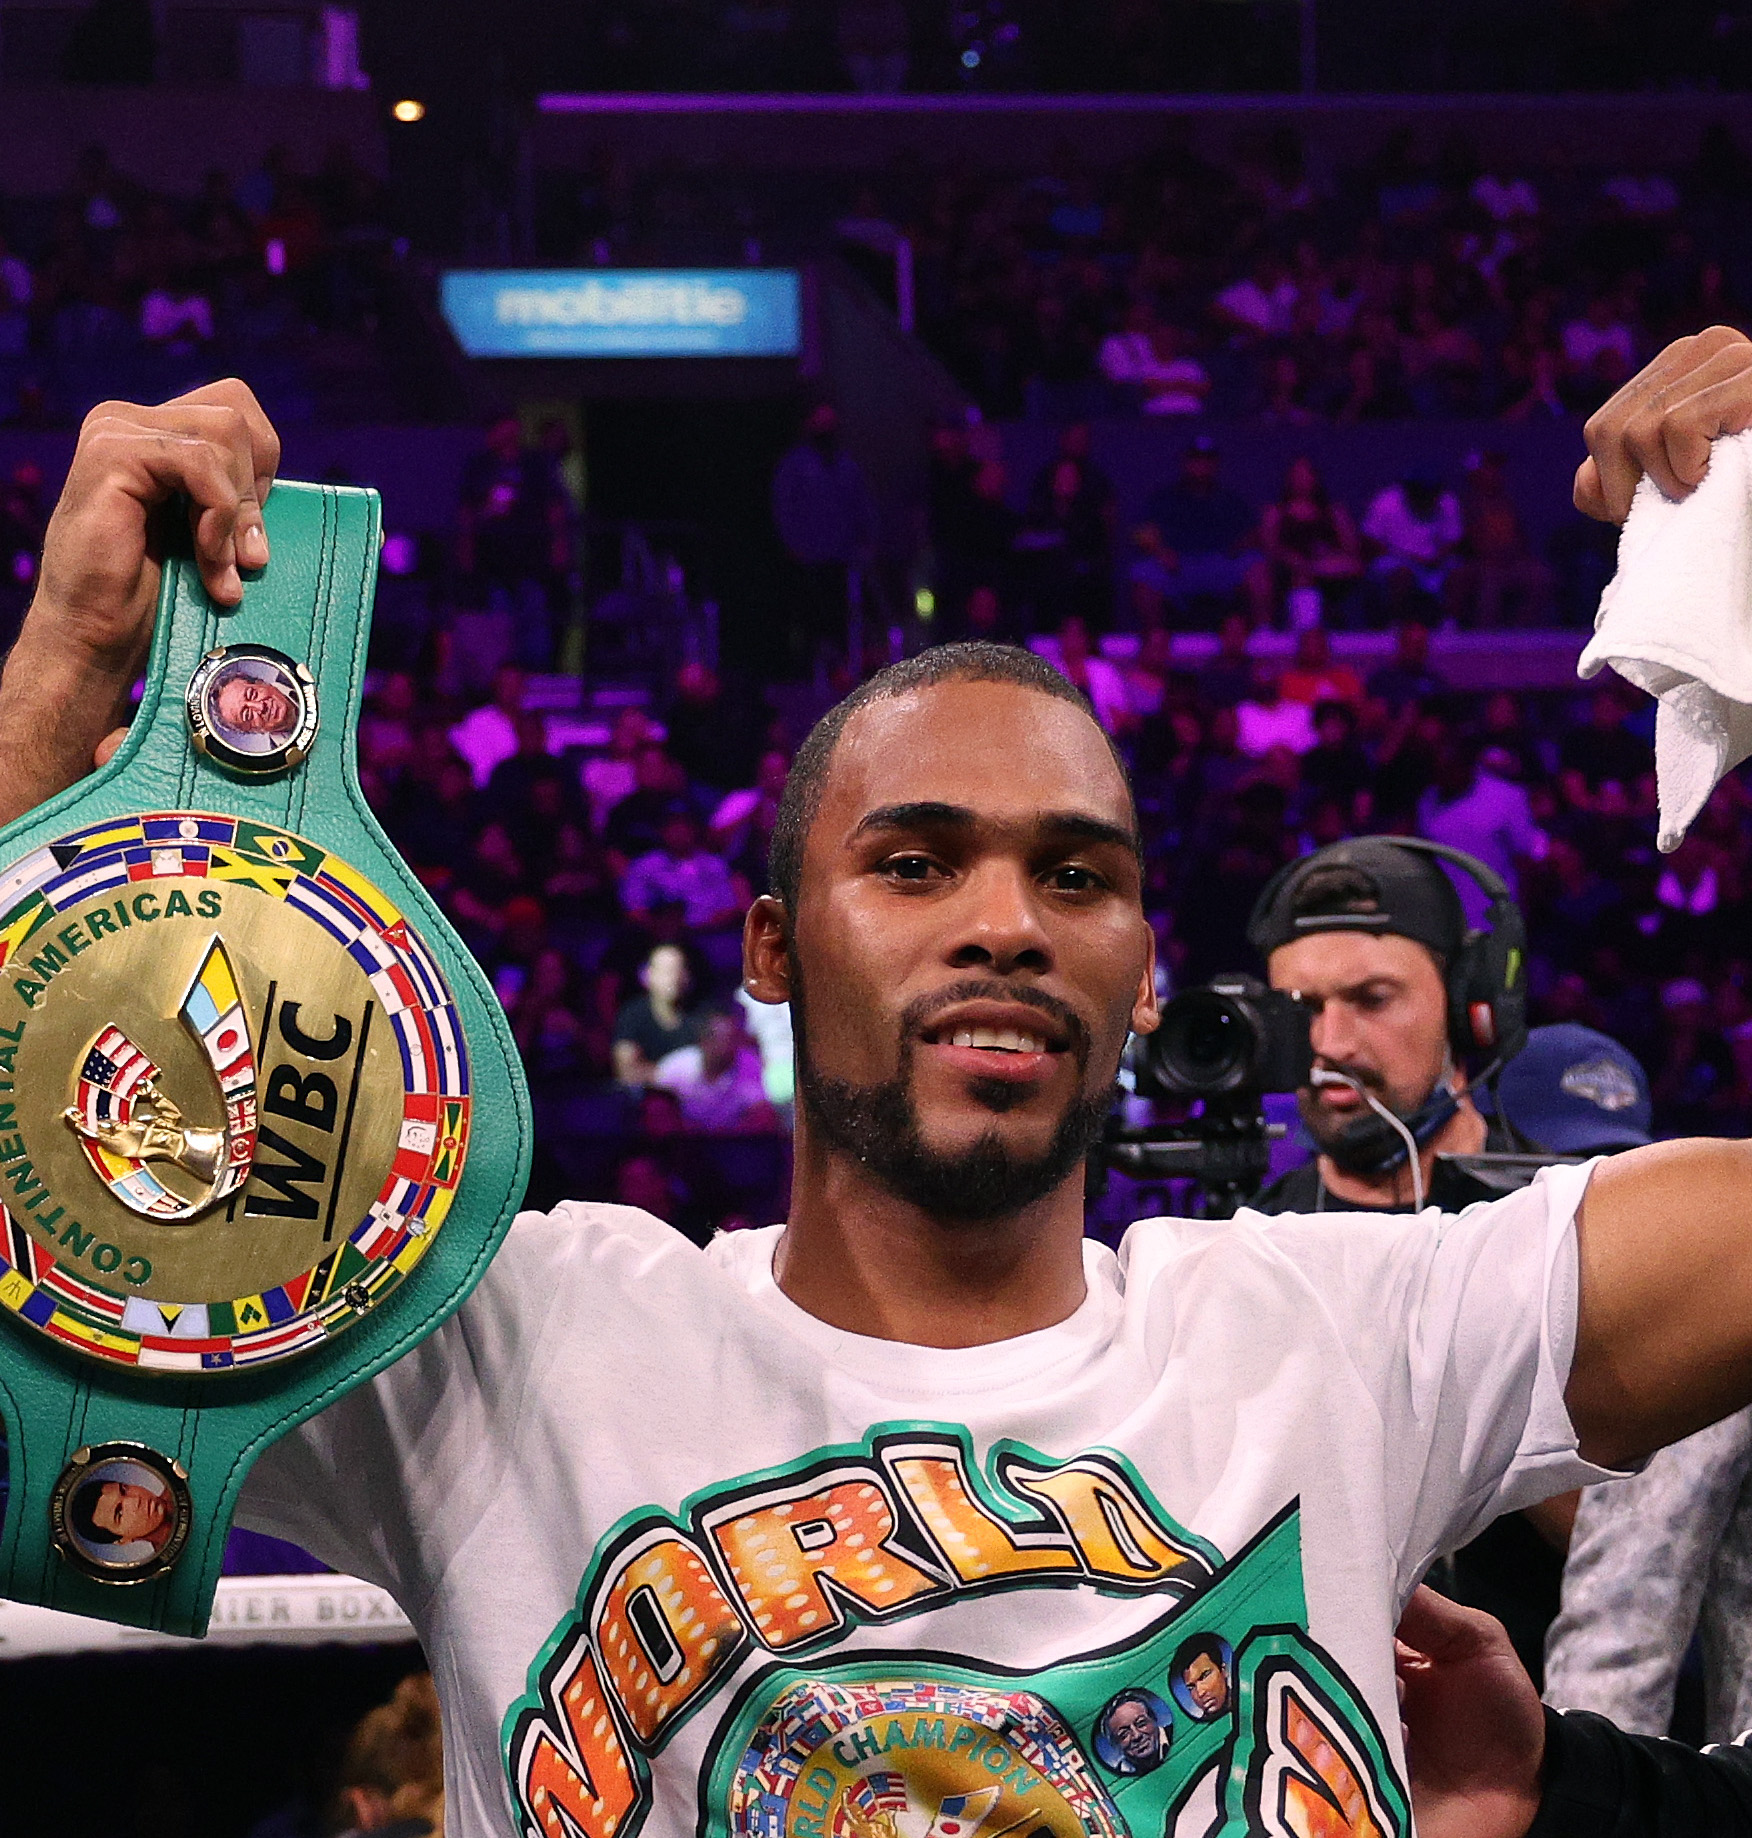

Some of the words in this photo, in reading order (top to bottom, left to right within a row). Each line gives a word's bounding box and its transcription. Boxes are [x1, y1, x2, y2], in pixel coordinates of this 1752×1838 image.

[14, 889, 224, 1008] AMERICAS
[245, 1001, 352, 1222] WBC
[833, 1717, 1041, 1796] CHAMPION
